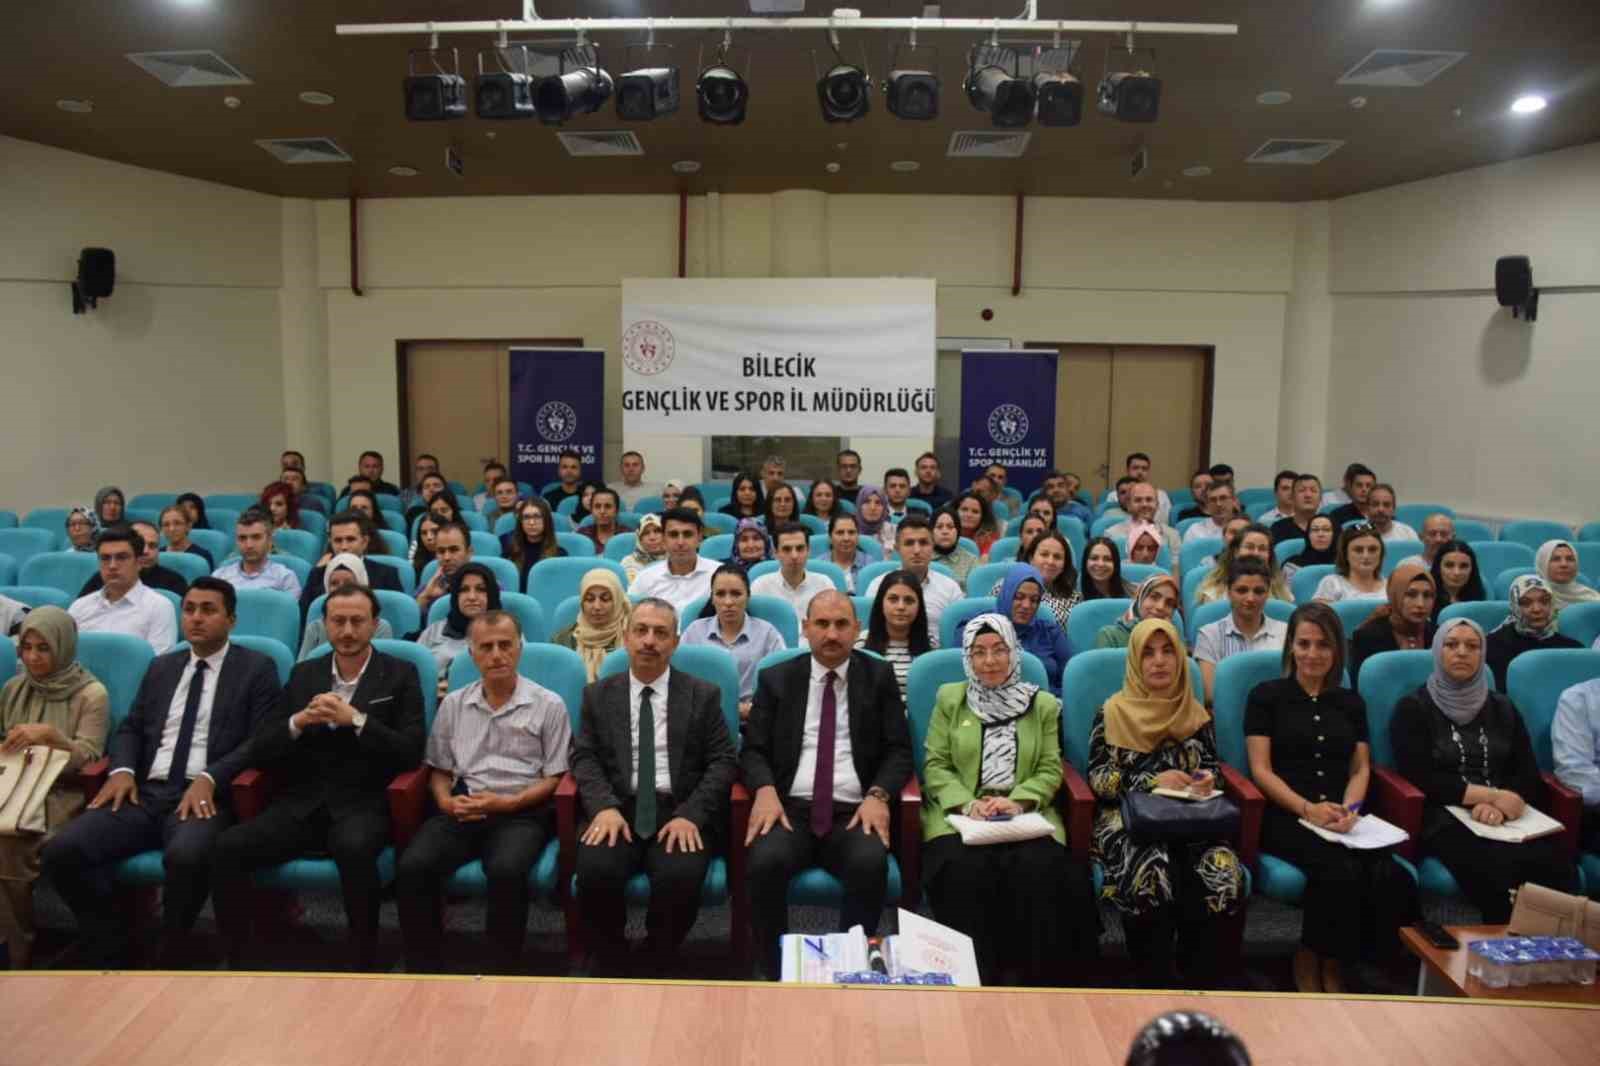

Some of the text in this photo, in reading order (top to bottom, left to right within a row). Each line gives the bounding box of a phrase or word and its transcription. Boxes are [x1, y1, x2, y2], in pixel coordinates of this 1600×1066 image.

[742, 352, 817, 378] BİLECİK
[622, 386, 937, 417] GENÇLİK VE SPOR İL MÜDÜRLÜĞÜ
[582, 444, 595, 454] VE
[968, 446, 1047, 458] T.C. GENÇLİK VE
[517, 454, 542, 464] SPOR
[968, 458, 993, 468] SPOR
